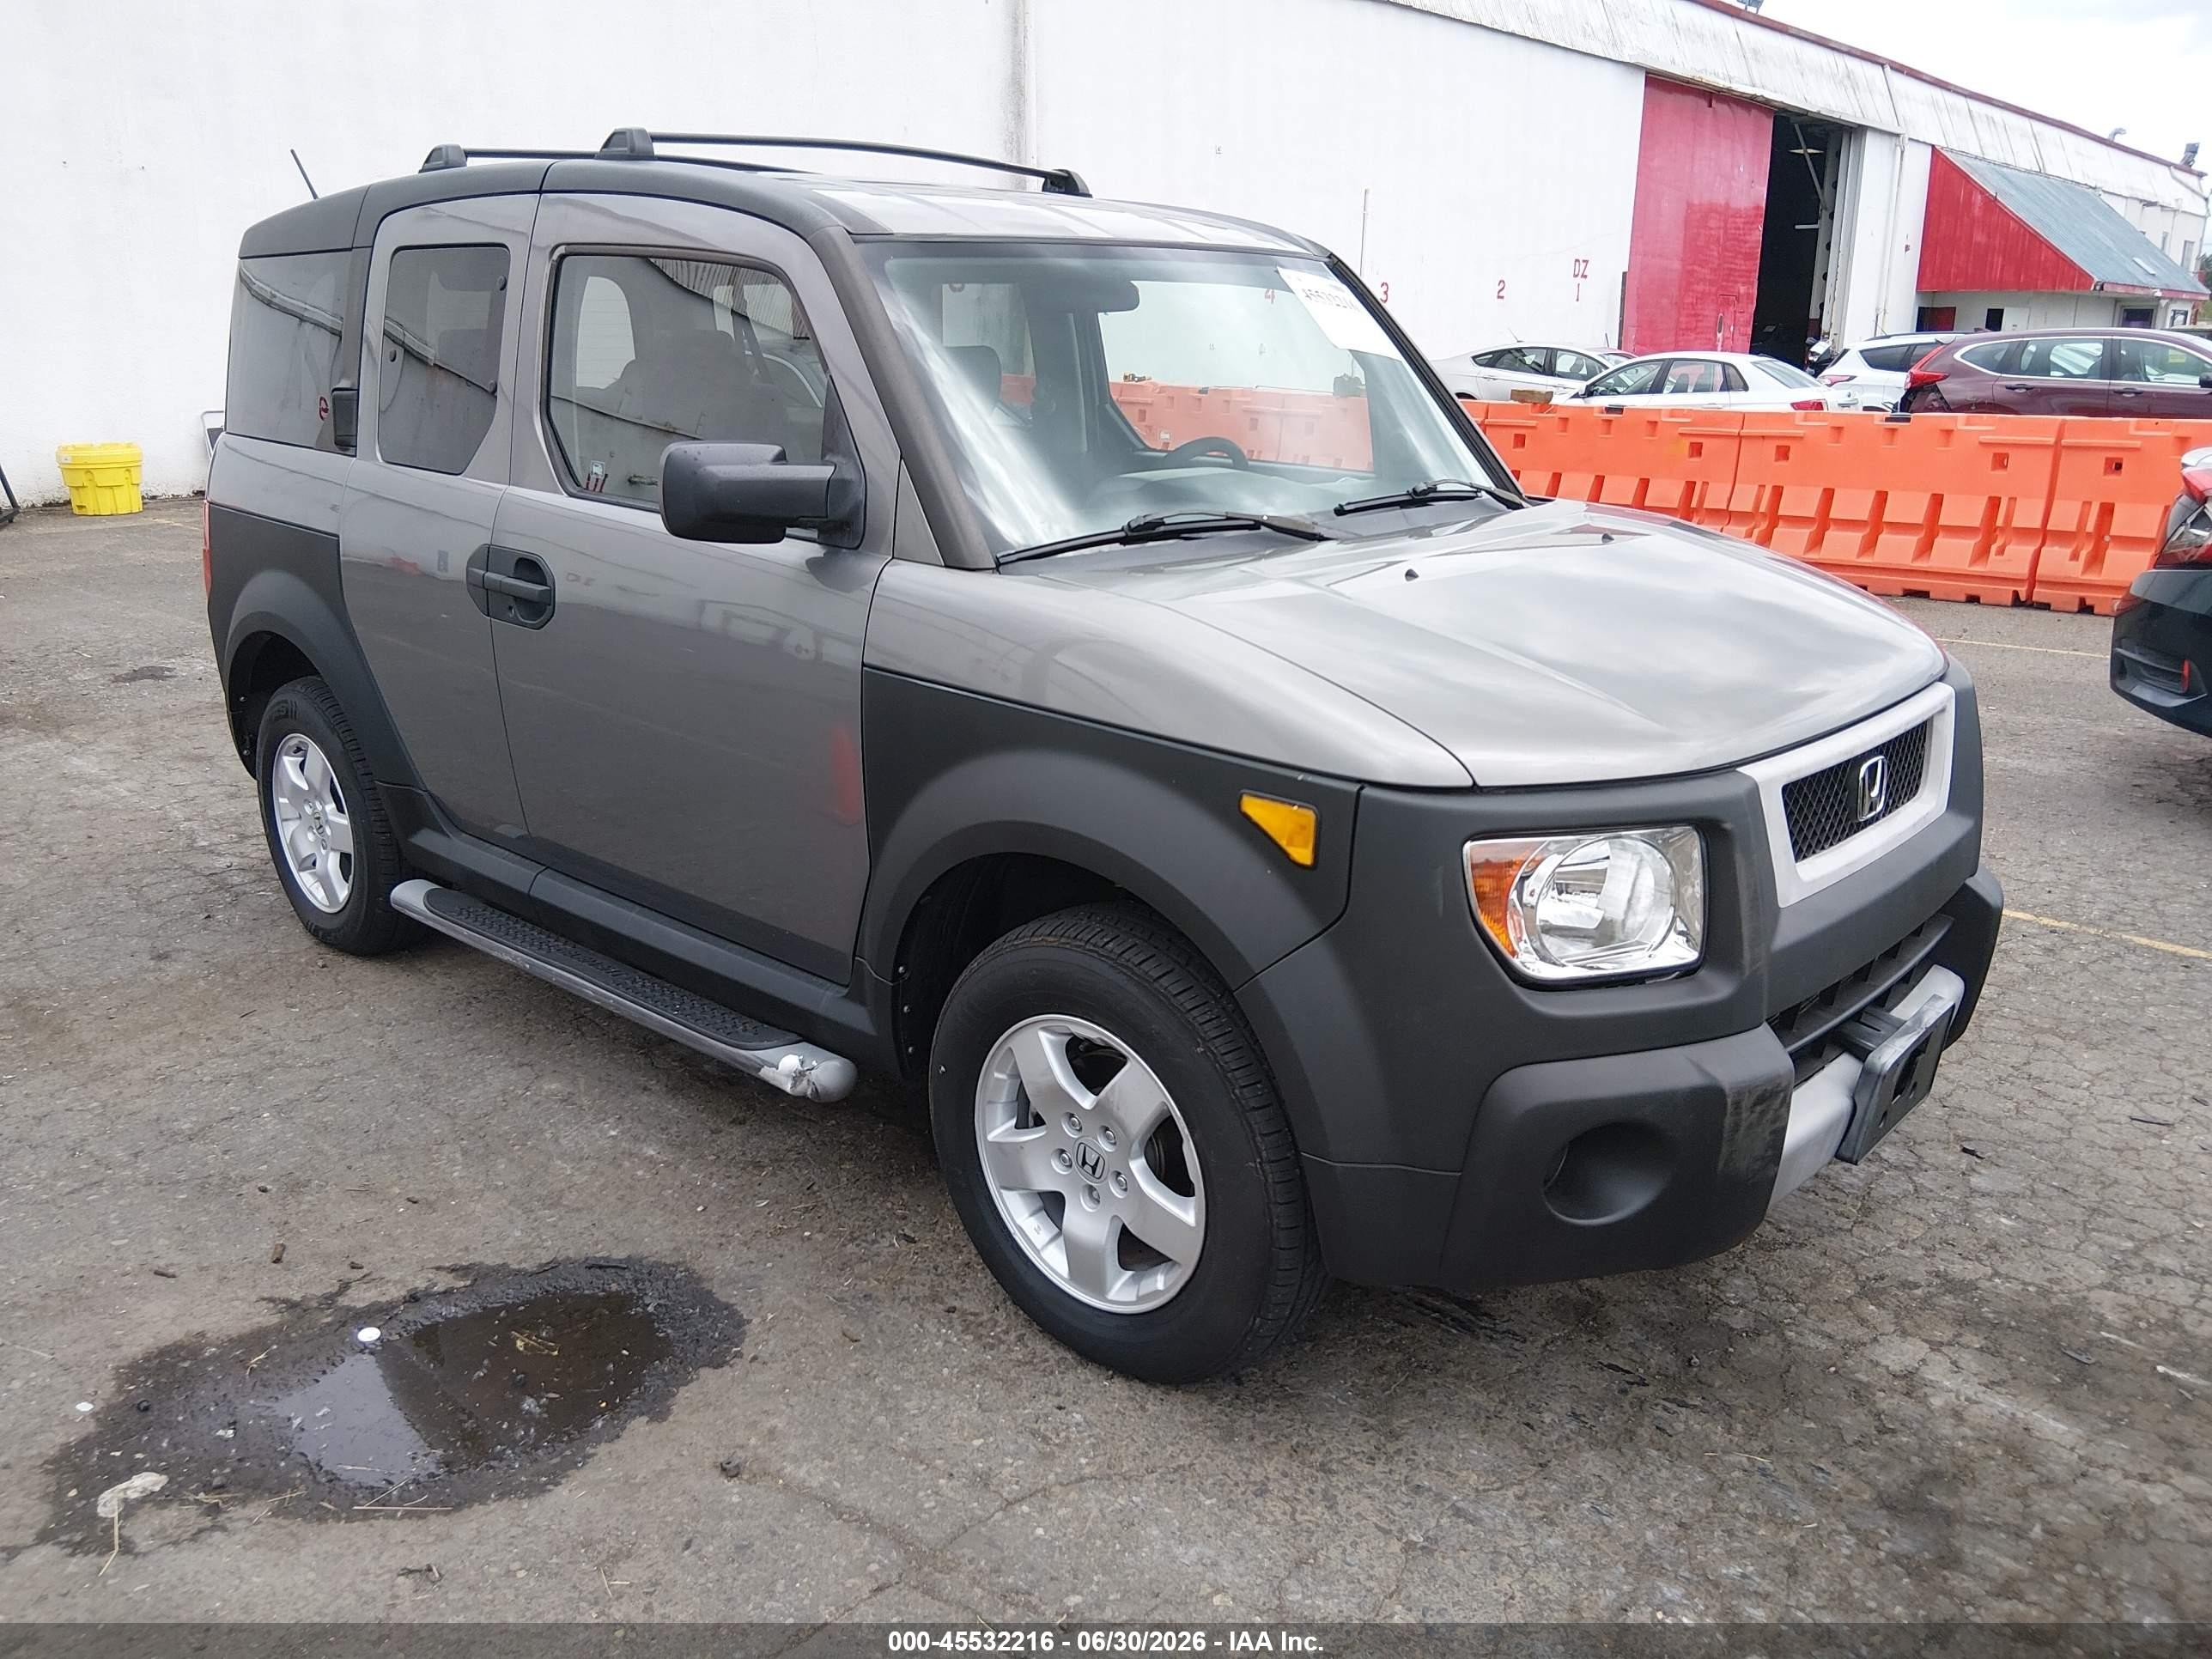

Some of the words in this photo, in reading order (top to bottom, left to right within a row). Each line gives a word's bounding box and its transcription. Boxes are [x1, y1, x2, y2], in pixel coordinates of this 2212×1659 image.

[1572, 258, 1589, 279] DZ
[1379, 282, 1389, 303] 3
[1497, 279, 1506, 300] 2
